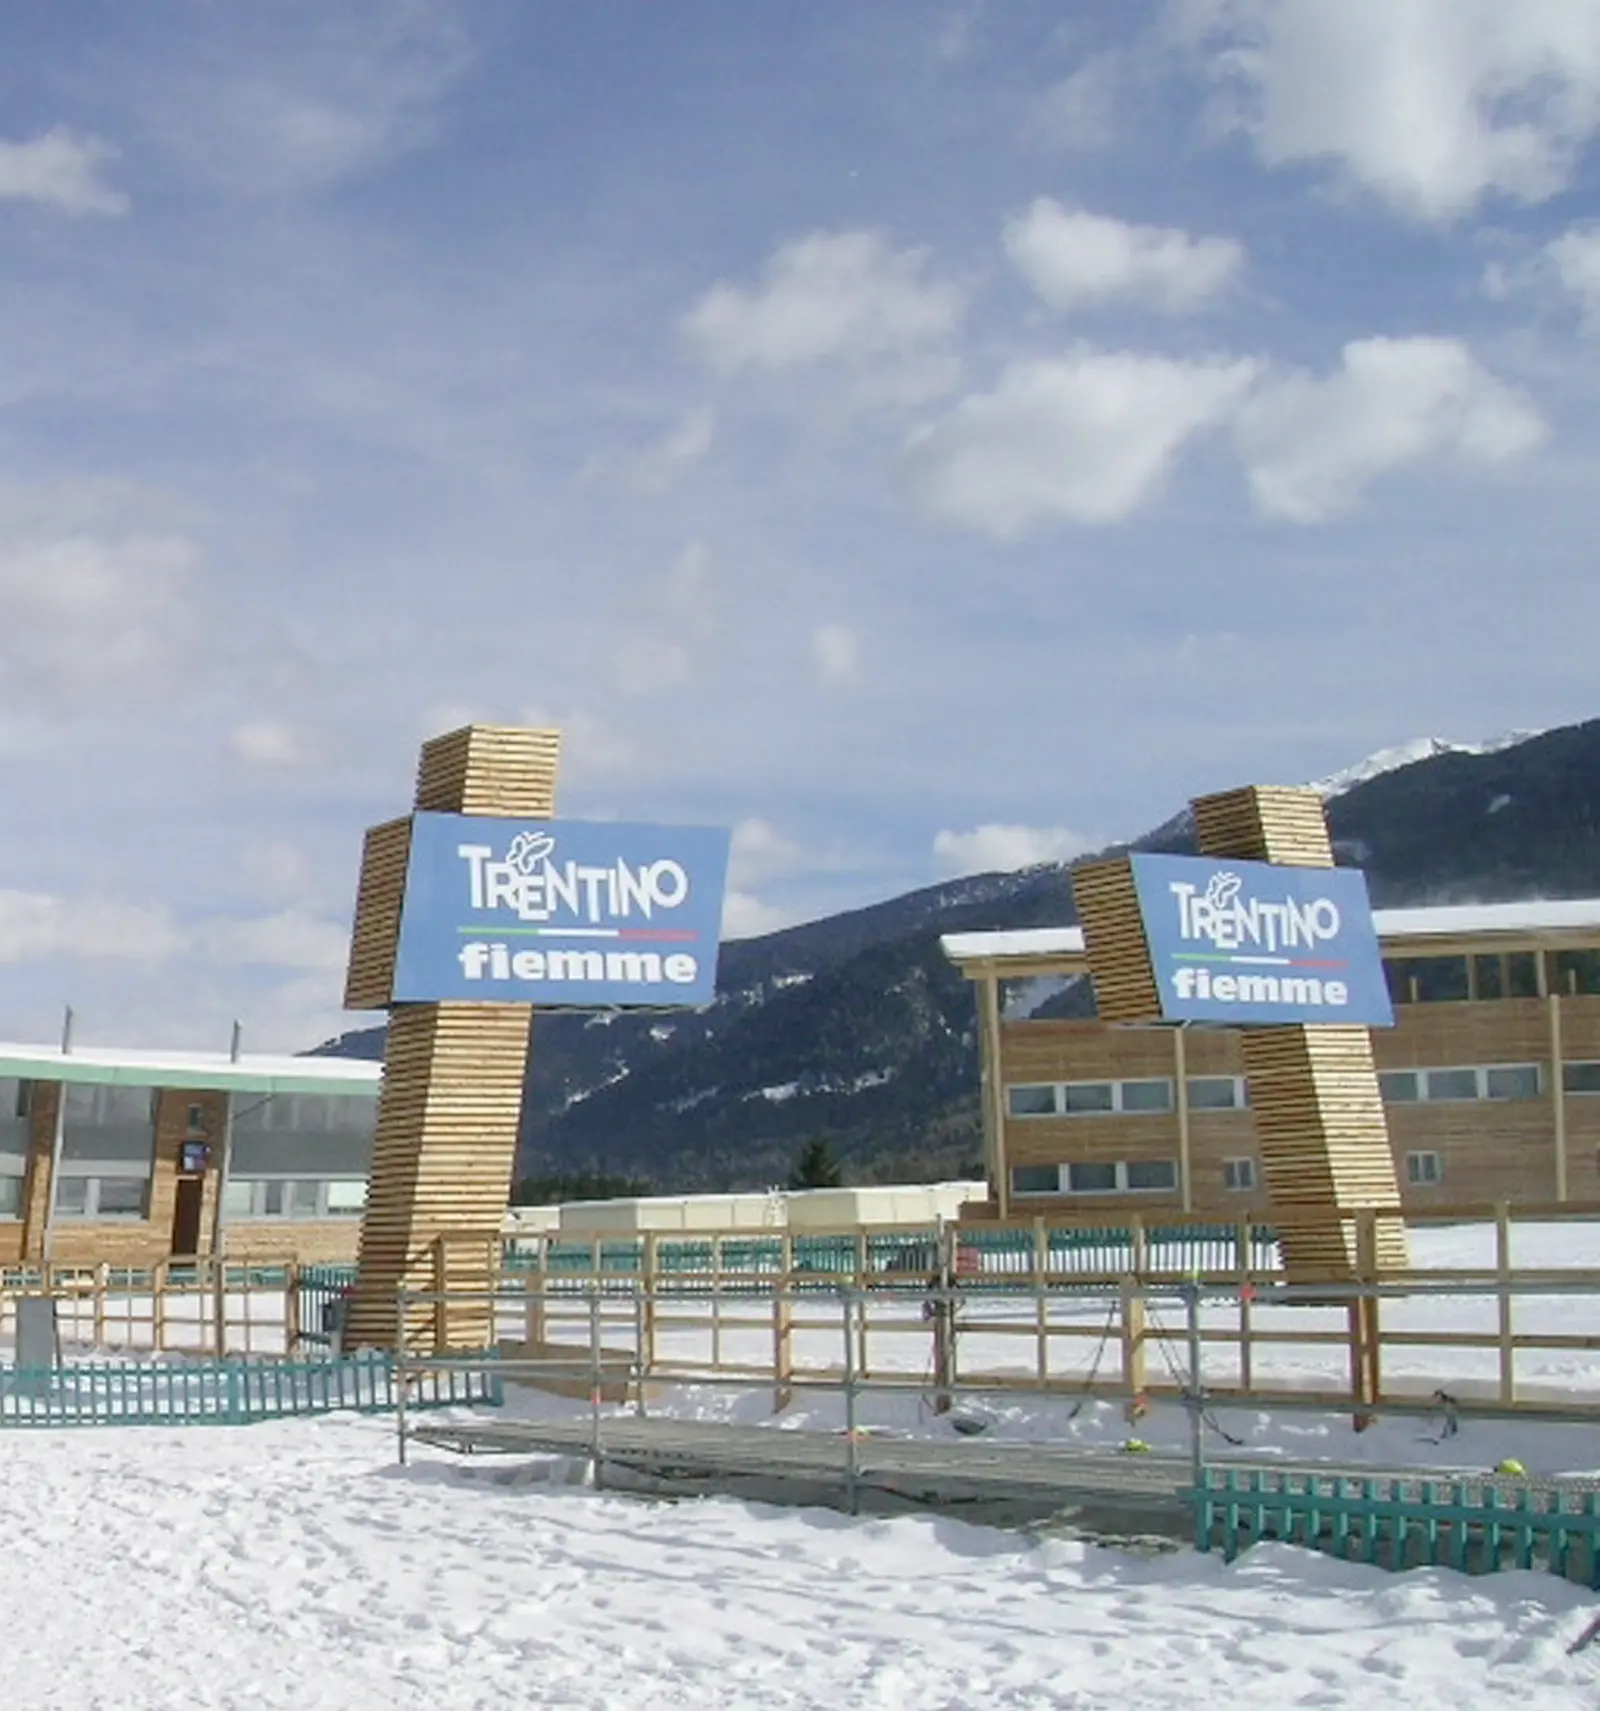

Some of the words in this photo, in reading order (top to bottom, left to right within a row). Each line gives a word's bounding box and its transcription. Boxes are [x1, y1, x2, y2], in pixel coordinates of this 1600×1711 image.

[458, 845, 688, 922] TRENTINO
[1170, 882, 1340, 952] TRENTINO
[458, 942, 697, 983] fiemme
[1173, 968, 1347, 1005] fiemme
